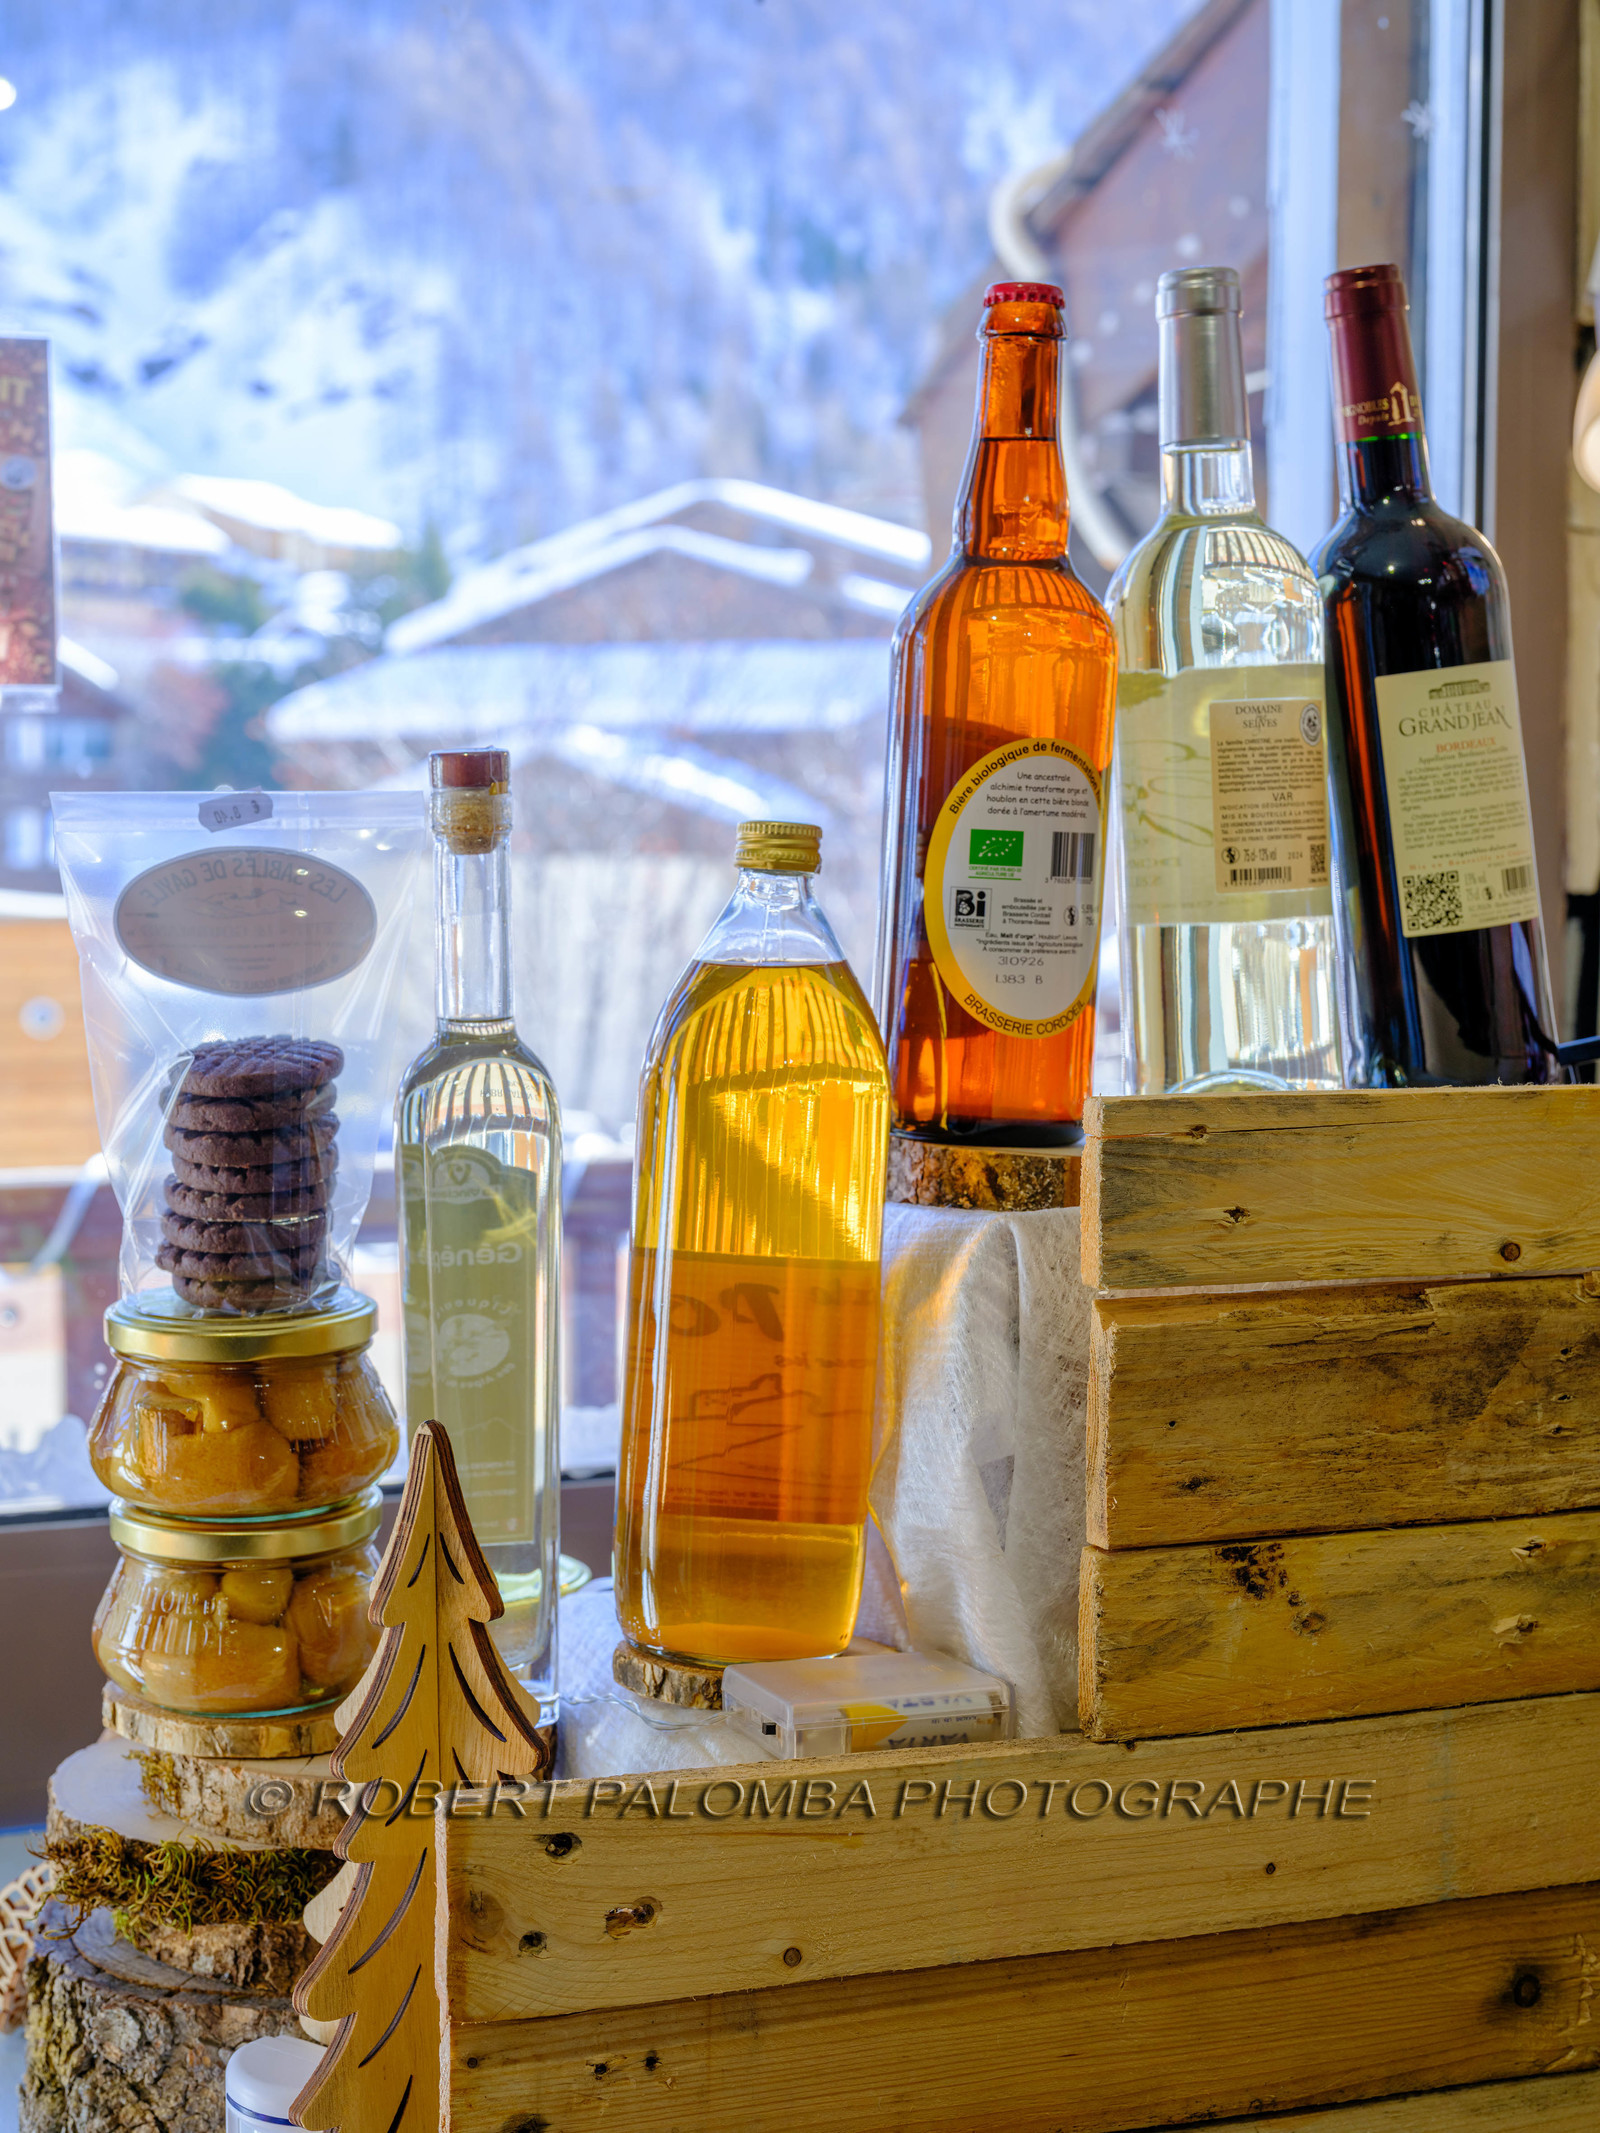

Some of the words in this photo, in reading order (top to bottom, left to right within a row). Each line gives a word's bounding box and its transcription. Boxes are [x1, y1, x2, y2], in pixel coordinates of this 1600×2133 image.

[1235, 704, 1283, 715] DOMAINE
[1418, 700, 1492, 718] CHÂTEAU
[1398, 714, 1470, 737] GRAND
[1472, 704, 1512, 731] JEAN
[1436, 736, 1496, 753] BORDEAUX
[949, 788, 974, 814] Bière
[972, 746, 1030, 786] biologique
[1033, 742, 1047, 752] de
[1050, 742, 1098, 787] fermentation
[1017, 772, 1032, 780] Une
[1034, 773, 1070, 782] ancestrale
[990, 782, 1022, 792] alchimie
[1025, 784, 1065, 794] transforme
[986, 794, 1017, 803] houblon
[1030, 796, 1050, 805] cette
[1052, 796, 1070, 806] bière
[1272, 792, 1294, 802] VAR
[987, 806, 1010, 815] dorée
[1012, 806, 1018, 815] à
[1020, 808, 1060, 817] l'amertume
[1251, 810, 1286, 818] BOUTEILLE
[956, 890, 986, 916] Bi
[1035, 975, 1043, 984] B
[964, 994, 1033, 1035] BRASSERIE
[1036, 1000, 1086, 1034] CORDOEIL
